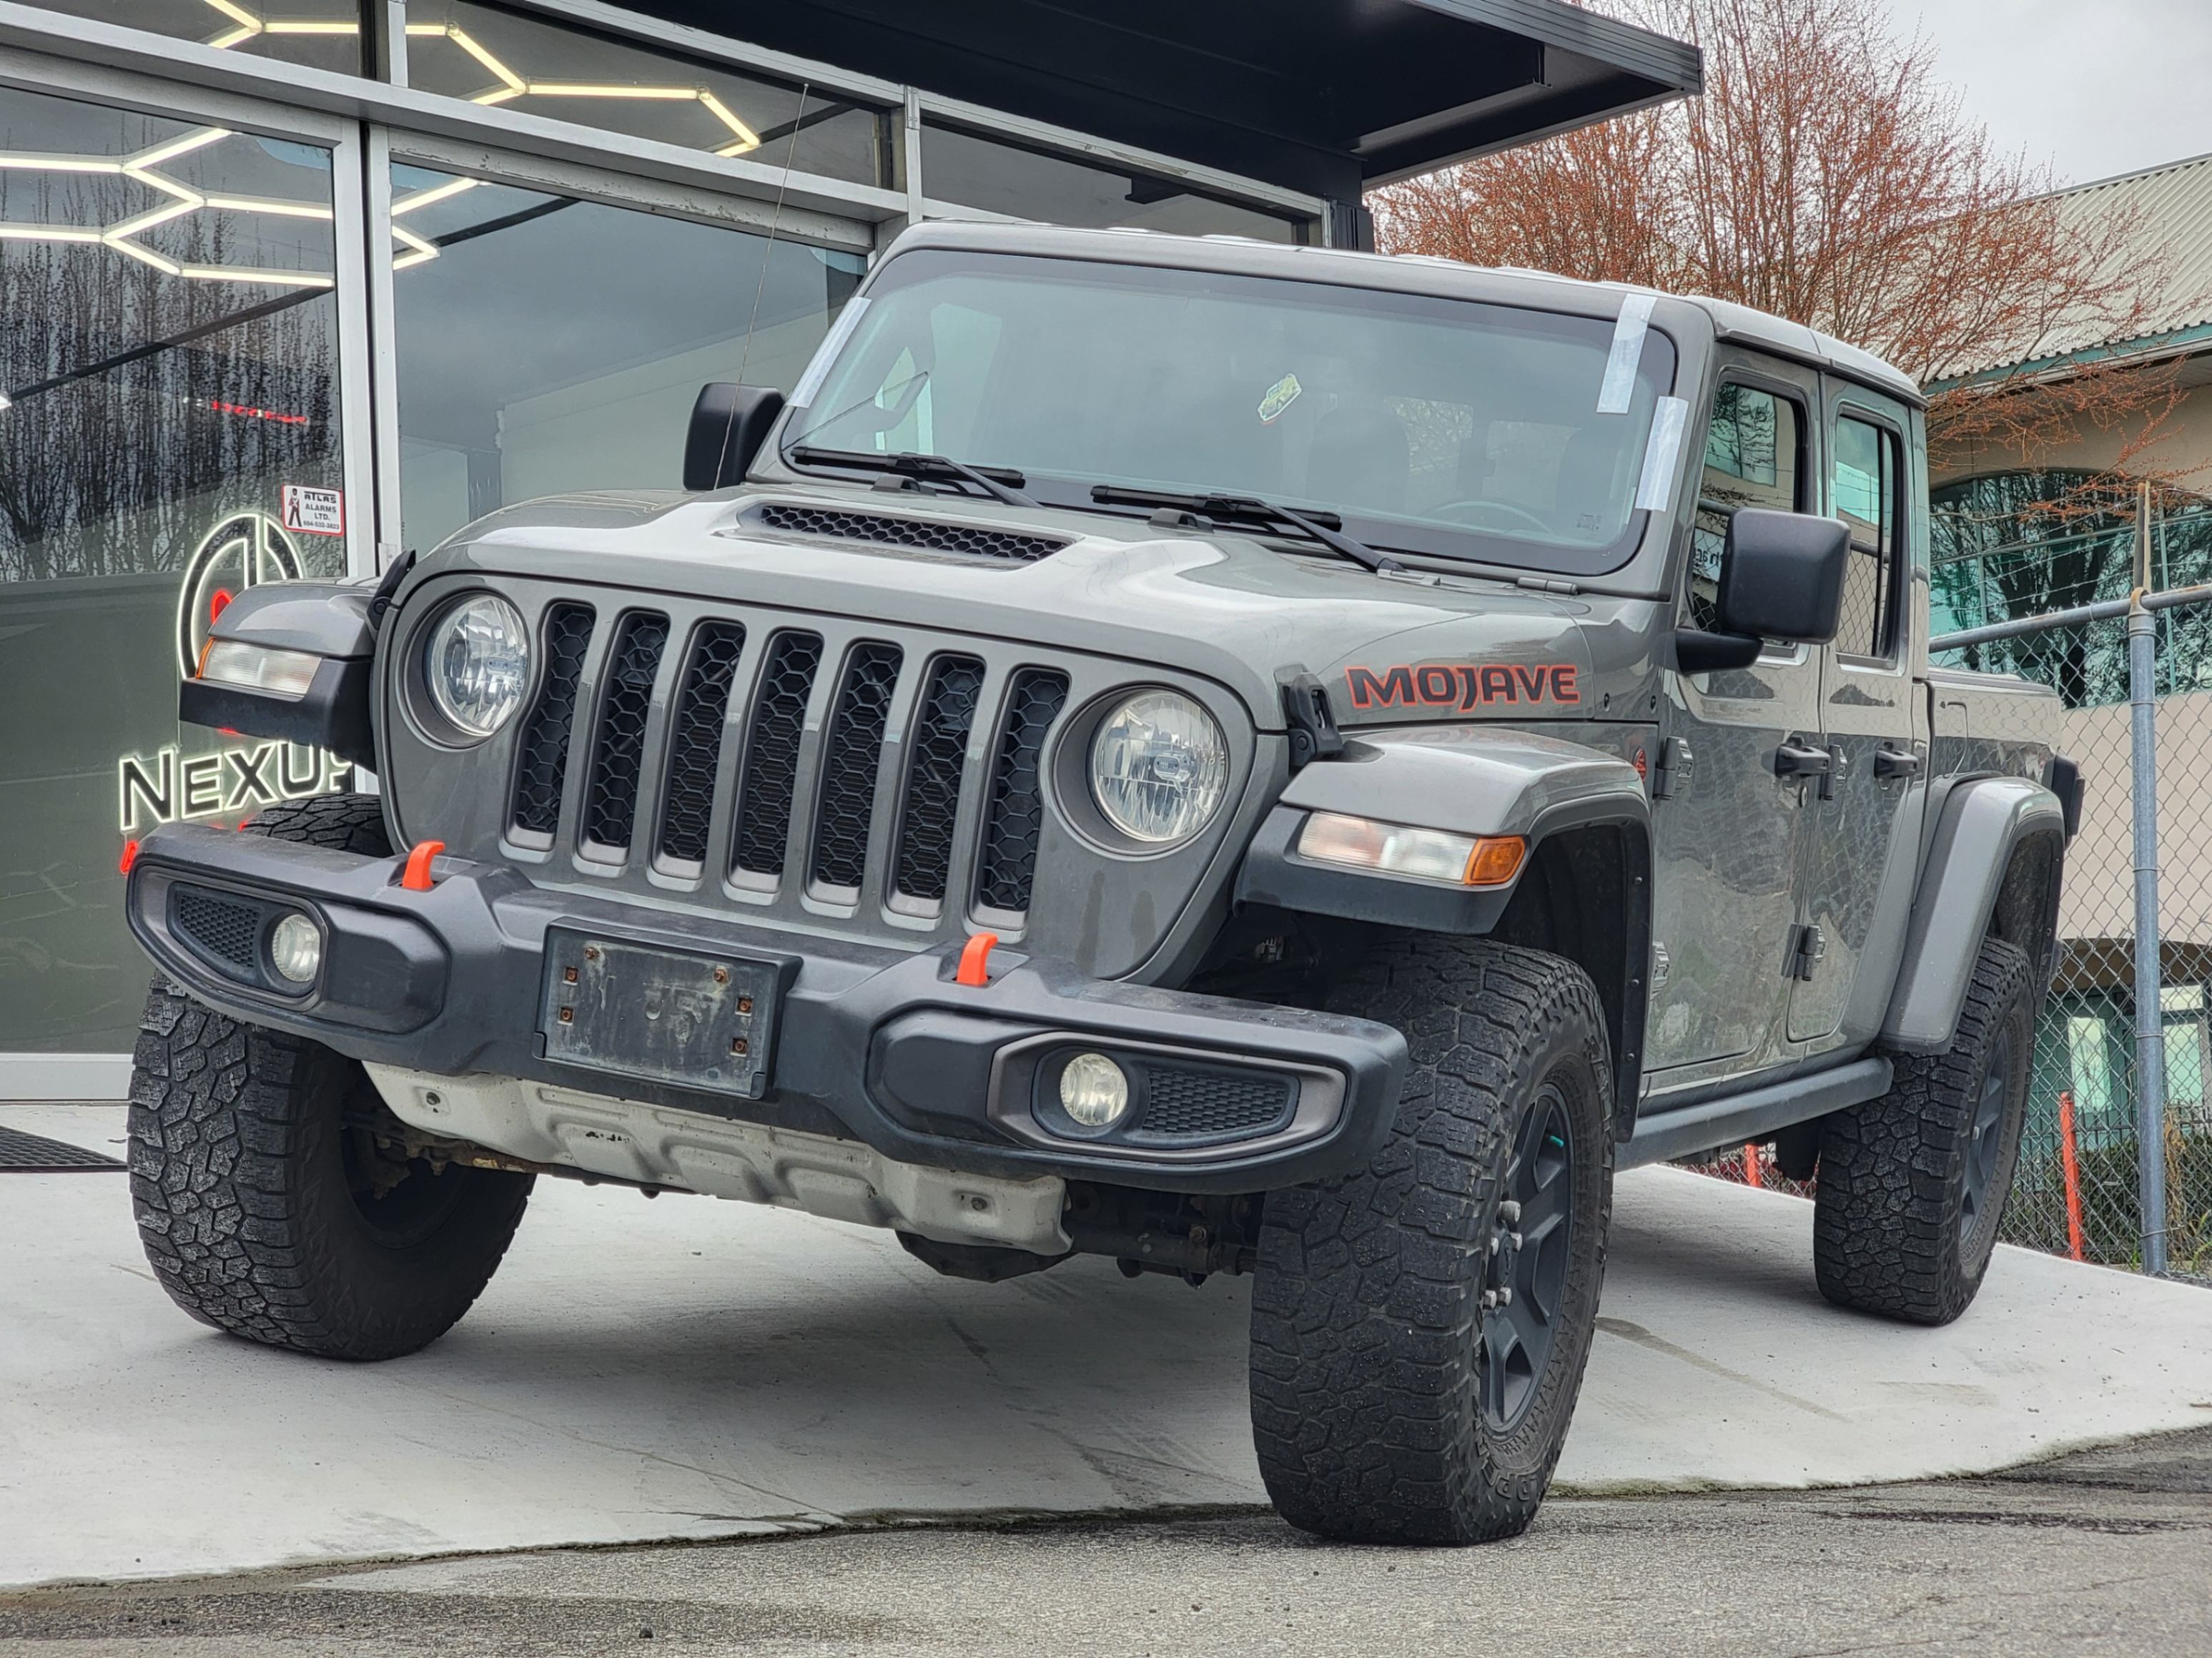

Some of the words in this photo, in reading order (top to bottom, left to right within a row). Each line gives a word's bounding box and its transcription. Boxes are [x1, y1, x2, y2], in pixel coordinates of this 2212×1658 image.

[305, 490, 337, 503] ATLAS
[305, 503, 337, 513] ALARMS
[1345, 664, 1580, 713] MOJAVE
